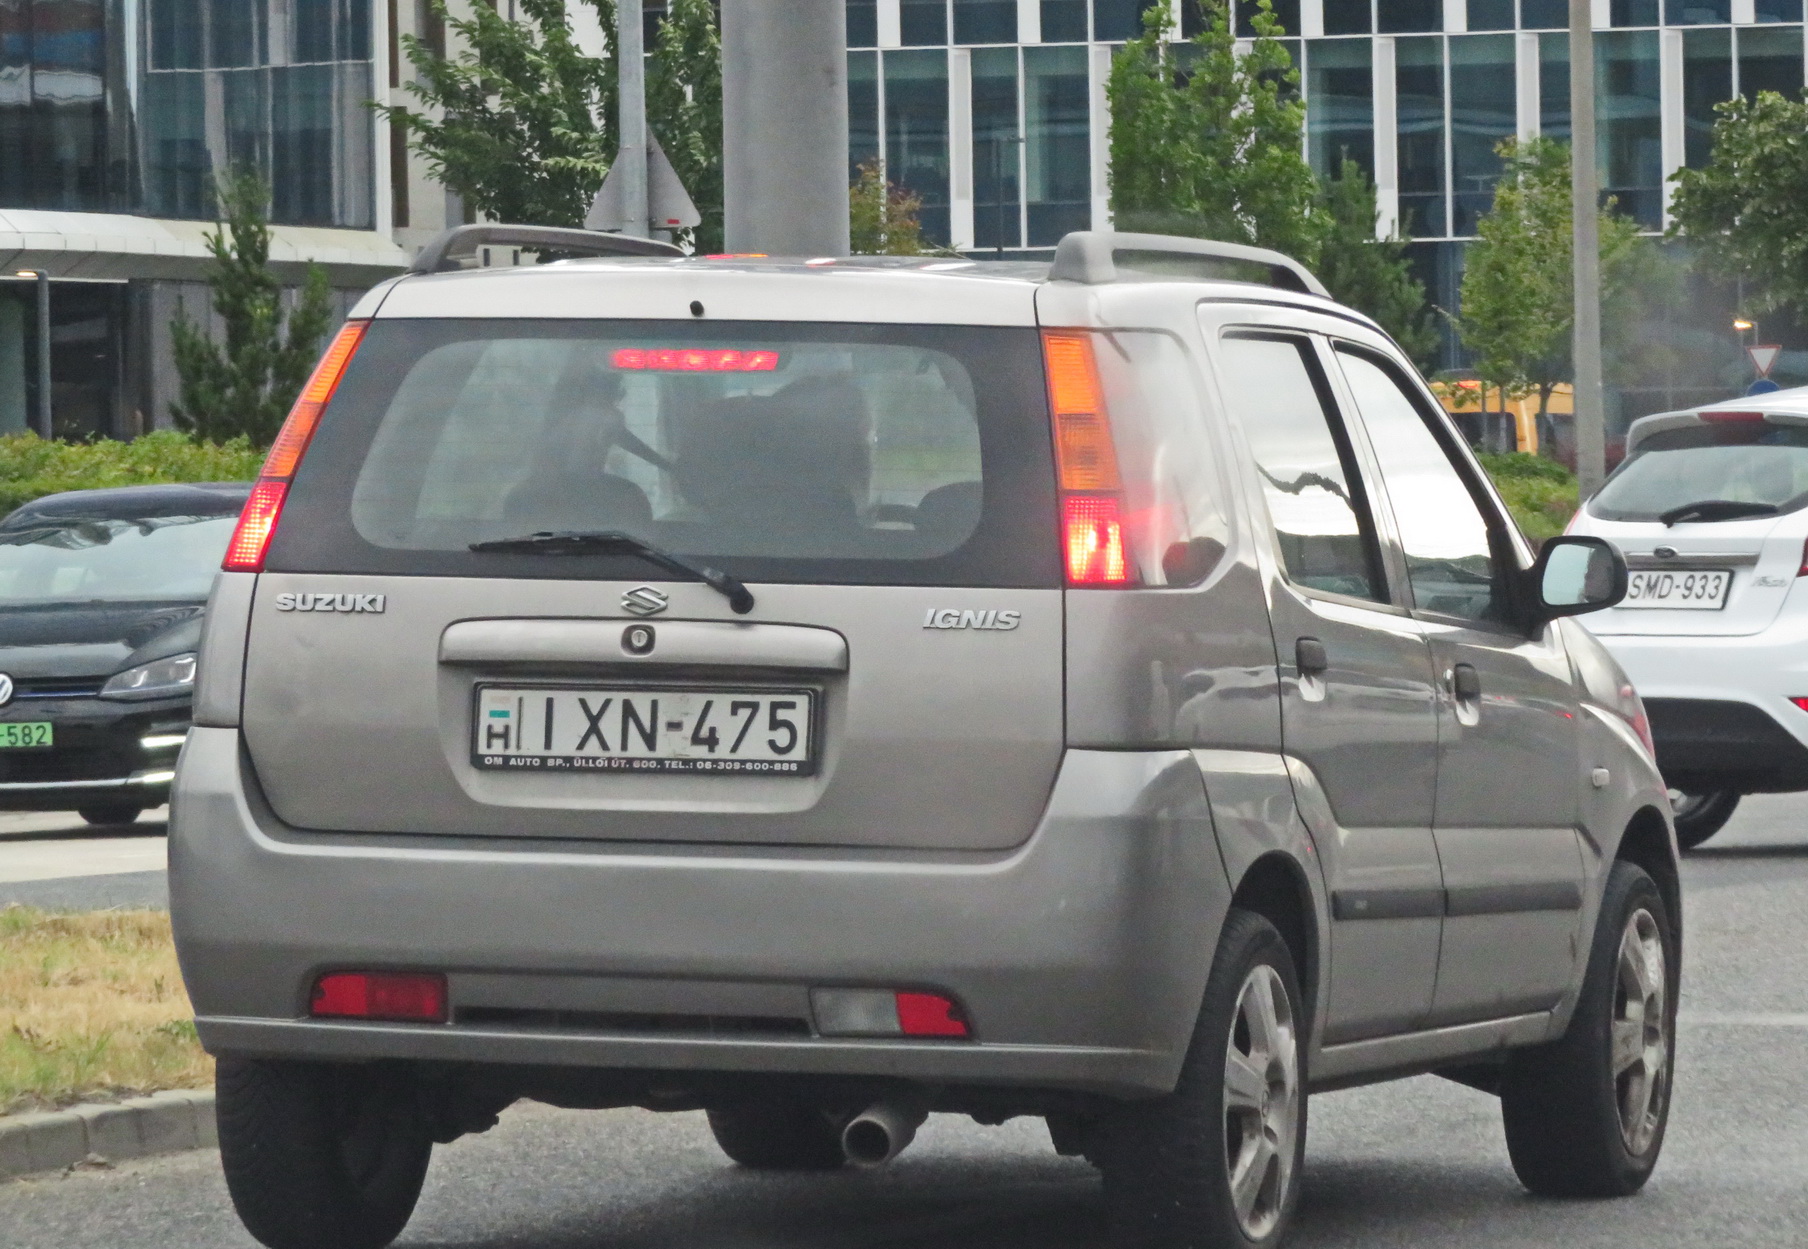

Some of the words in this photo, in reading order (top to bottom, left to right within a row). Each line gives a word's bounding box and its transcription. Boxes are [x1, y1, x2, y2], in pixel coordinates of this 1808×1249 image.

[1628, 573, 1722, 600] SMD-933
[276, 592, 385, 613] SUZUKI
[922, 608, 1020, 631] IGNIS
[544, 696, 798, 755] IXN-475
[484, 756, 503, 766] OM
[509, 757, 541, 767] AUTO
[664, 760, 693, 769] TEL.:
